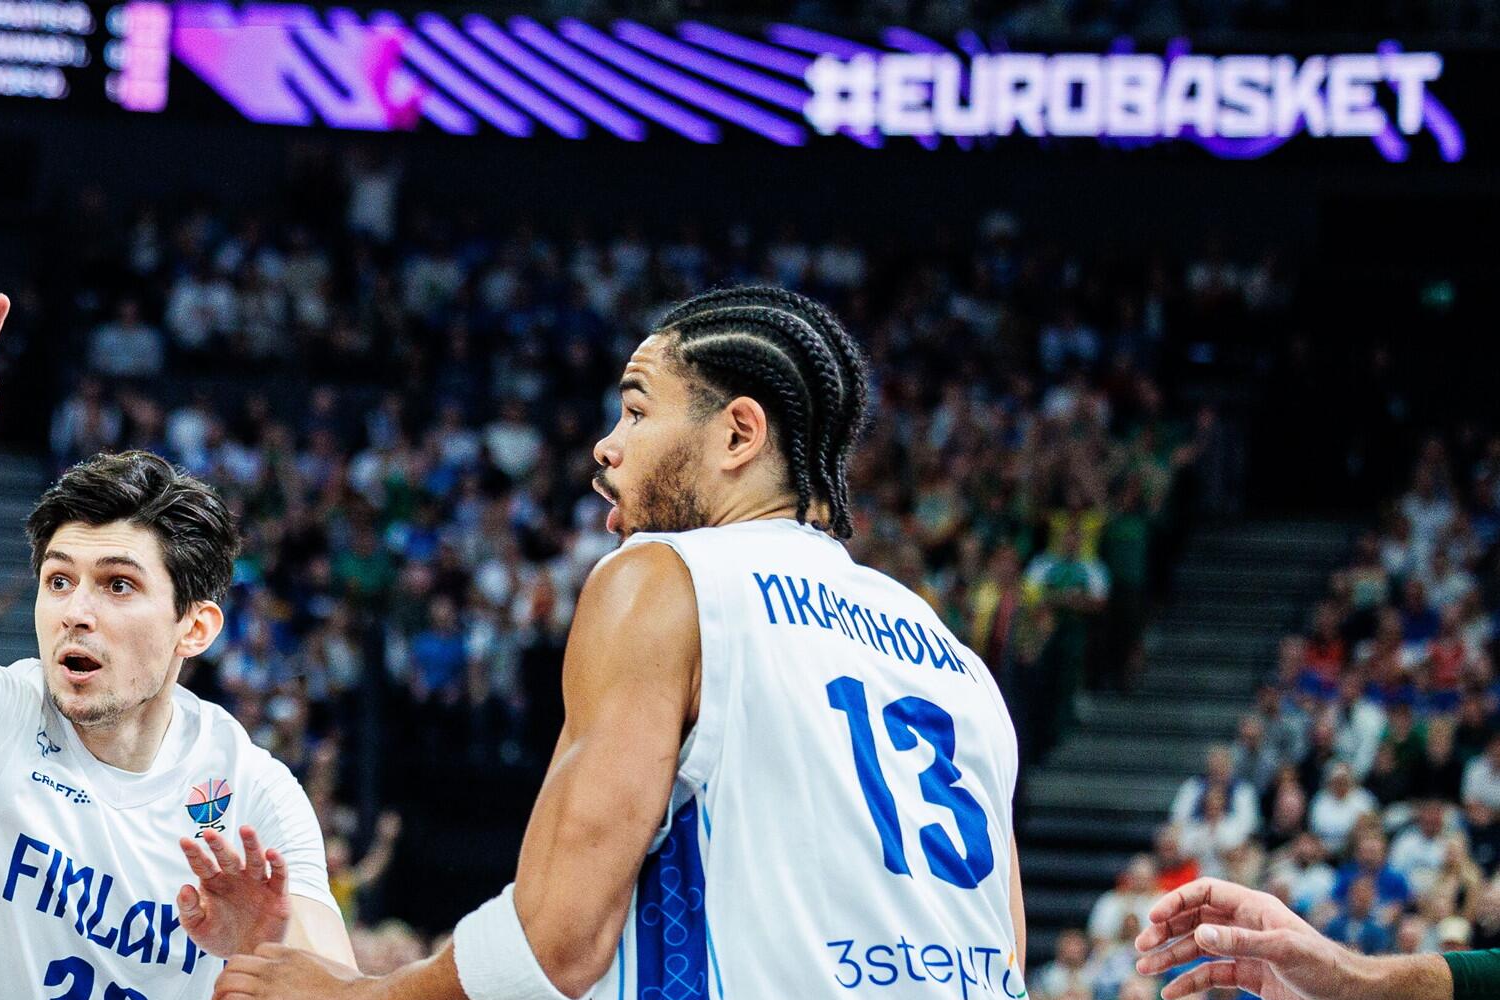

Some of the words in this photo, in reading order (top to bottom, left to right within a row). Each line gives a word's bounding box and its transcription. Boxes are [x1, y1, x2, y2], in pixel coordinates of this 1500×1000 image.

[803, 53, 1443, 137] #EUROBASKET
[31, 771, 77, 798] CRAFT
[825, 675, 995, 890] 13
[2, 832, 228, 976] FINLAN
